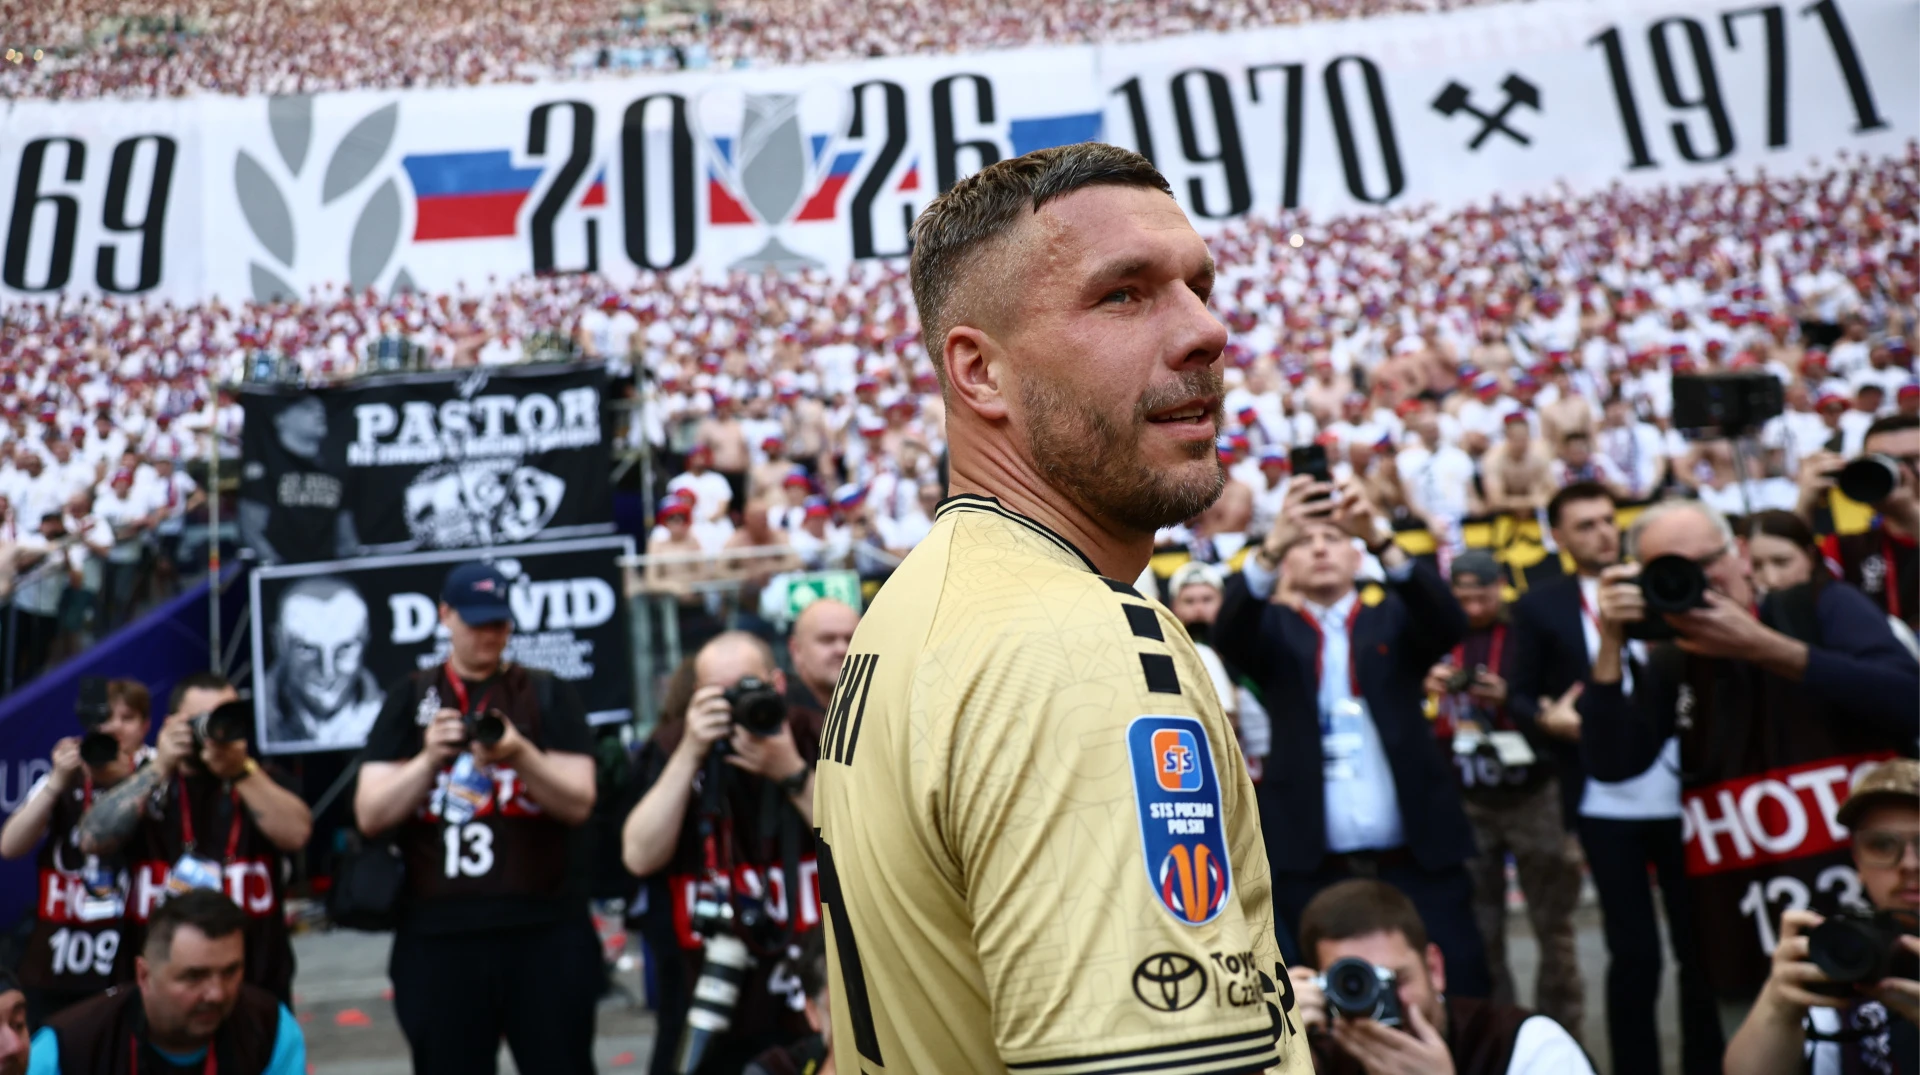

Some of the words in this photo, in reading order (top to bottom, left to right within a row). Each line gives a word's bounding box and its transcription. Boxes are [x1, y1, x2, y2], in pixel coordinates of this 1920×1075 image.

[1588, 0, 1892, 170] 1971
[1111, 55, 1406, 220] 1970
[2, 134, 177, 294] 69
[353, 386, 600, 446] PASTOR
[1164, 745, 1194, 774] STS
[1150, 802, 1174, 819] STS
[1174, 802, 1214, 818] PUCHAR
[1167, 819, 1206, 834] POLSKI
[1682, 761, 1878, 866] HOT
[444, 822, 494, 878] 13
[49, 926, 121, 976] 109
